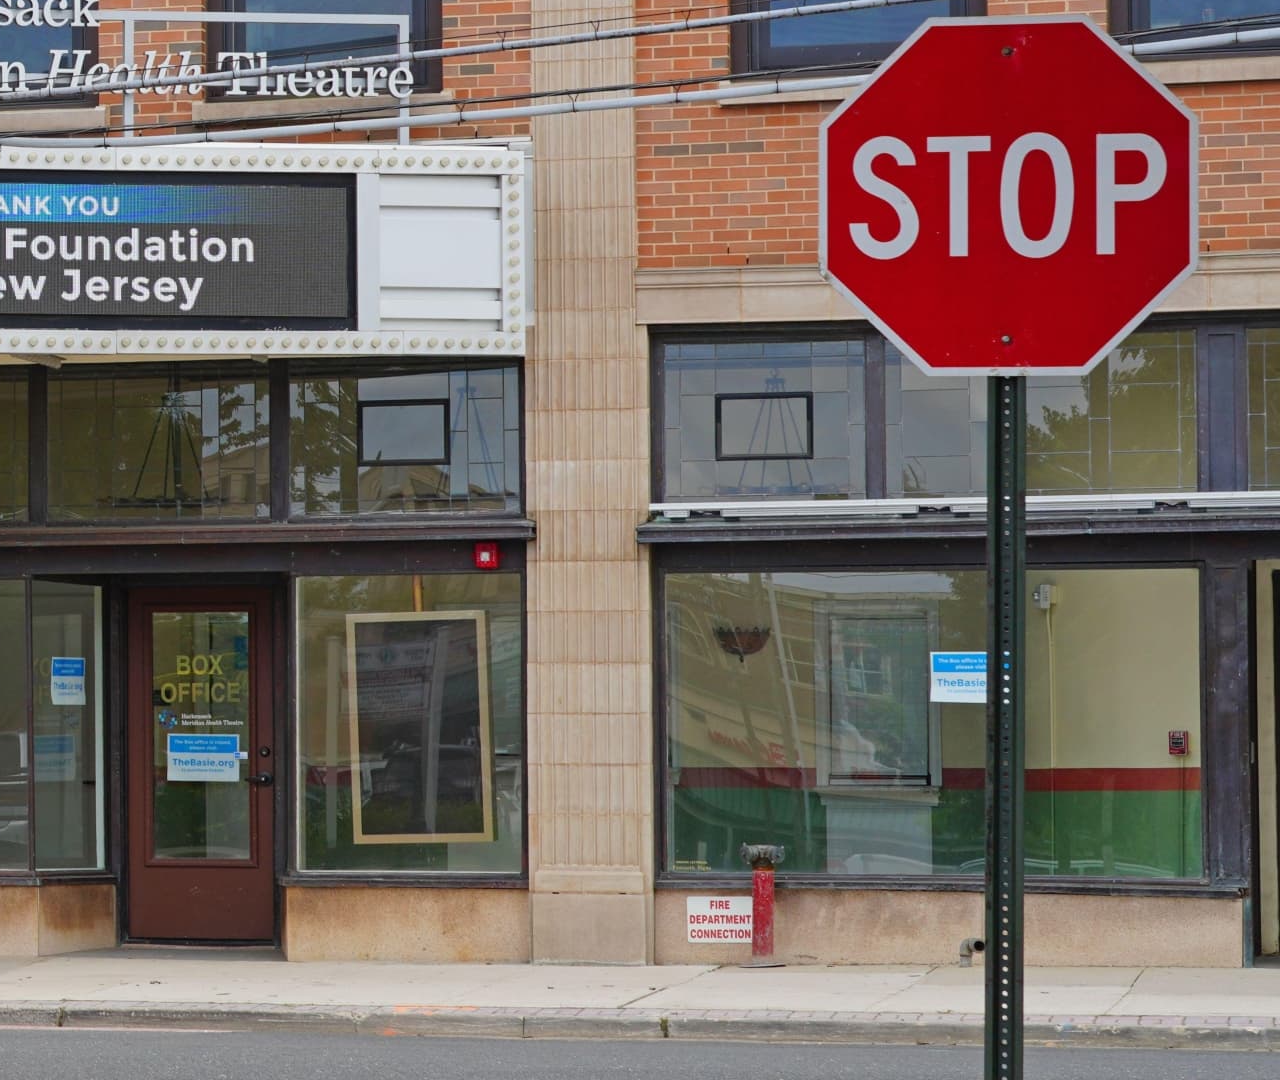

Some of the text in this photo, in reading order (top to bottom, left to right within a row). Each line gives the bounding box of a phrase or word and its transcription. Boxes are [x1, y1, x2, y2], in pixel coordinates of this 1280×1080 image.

[43, 49, 204, 96] Health
[216, 51, 414, 99] Theatre
[60, 194, 121, 217] YOU
[848, 131, 1168, 261] STOP
[4, 226, 256, 263] Foundation
[60, 268, 205, 312] Jersey
[176, 655, 223, 676] BOX
[160, 682, 241, 704] OFFICE
[937, 678, 986, 687] TheBasie
[172, 758, 235, 769] TheBasie.org
[709, 900, 731, 910] FIRE
[689, 914, 752, 925] DEPARTMENT
[690, 929, 752, 939] CONNECTION
